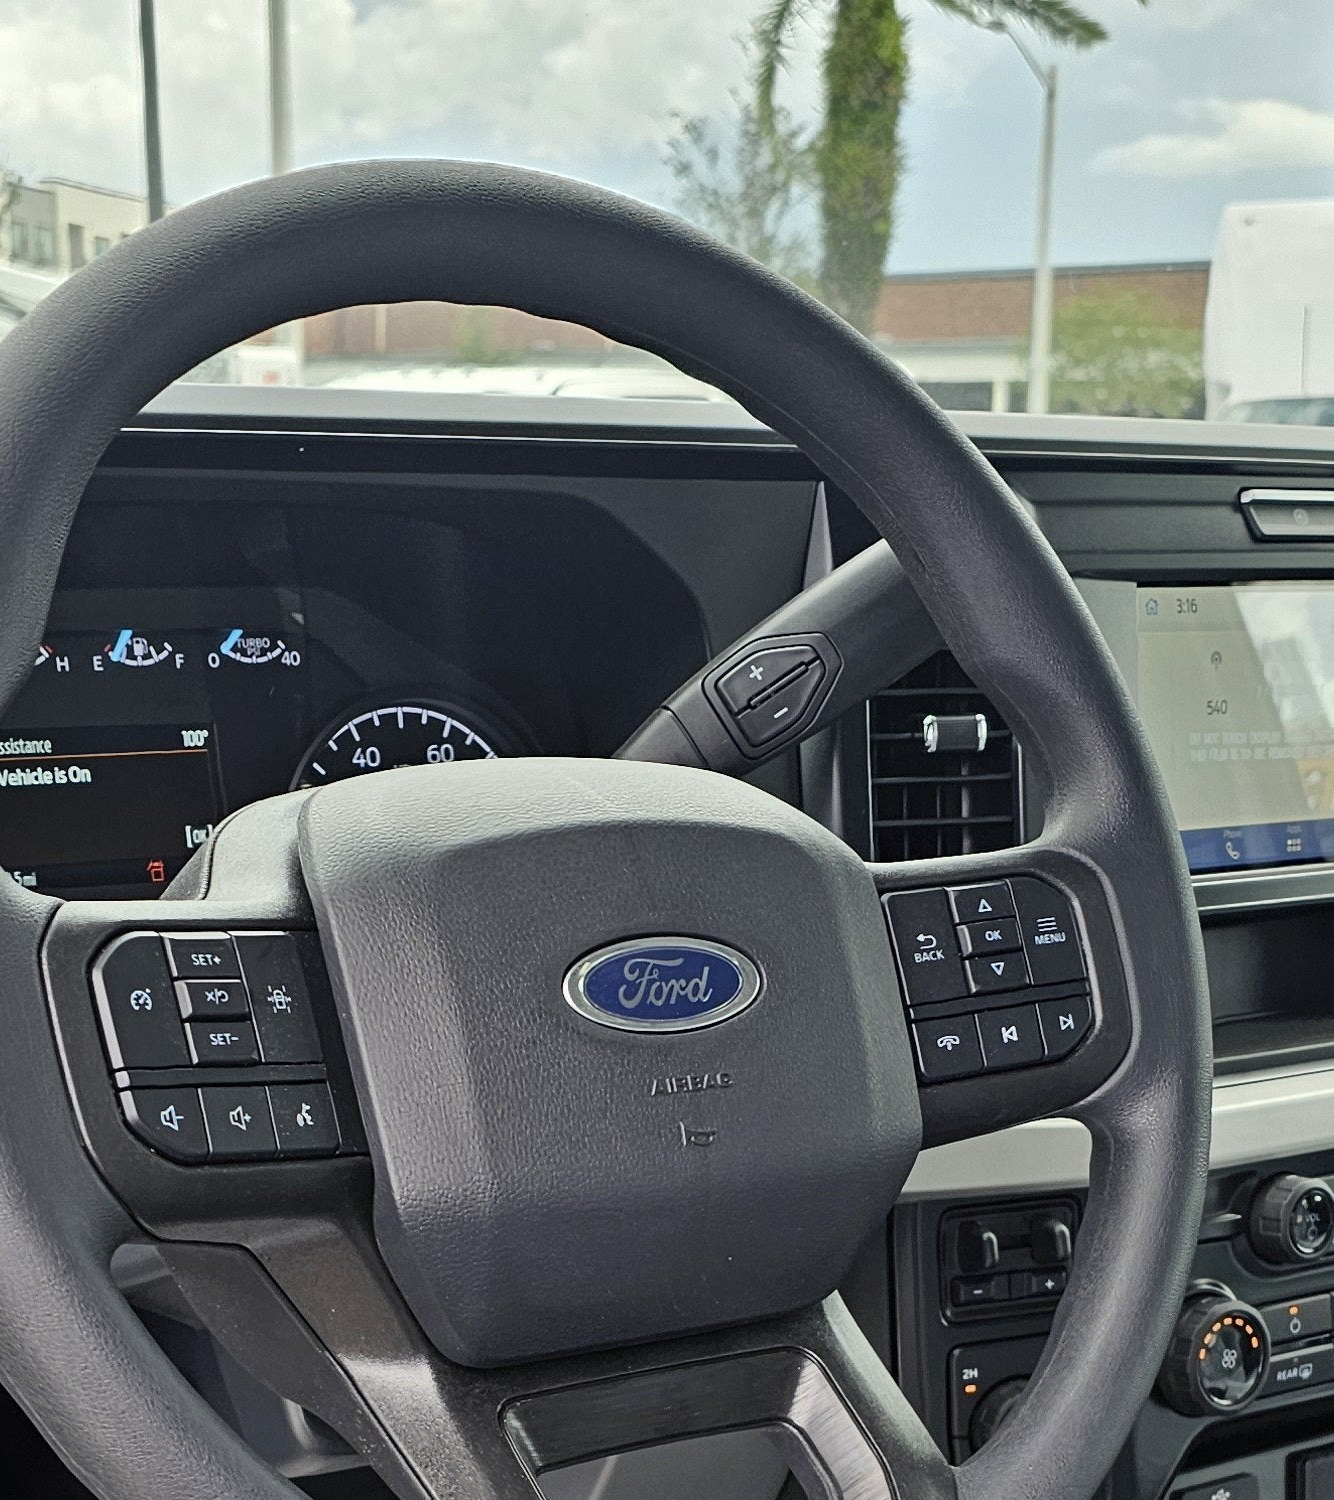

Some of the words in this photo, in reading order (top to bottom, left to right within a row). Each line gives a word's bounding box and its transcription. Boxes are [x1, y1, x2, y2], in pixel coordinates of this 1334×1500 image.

[1176, 598, 1198, 614] 3:16
[236, 637, 270, 649] TURBO
[56, 656, 70, 672] H
[93, 655, 104, 672] E
[176, 654, 184, 669] F
[281, 650, 301, 666] 40
[1207, 700, 1228, 716] 540
[352, 746, 381, 768] 40
[426, 743, 455, 763] 60
[54, 767, 67, 784] is
[68, 766, 92, 783] On
[984, 930, 1003, 942] OK
[1034, 932, 1066, 945] MENU
[914, 949, 945, 963] BACK
[618, 957, 713, 1009] Ford
[651, 1072, 733, 1096] AIRBAG
[962, 1368, 979, 1380] 2H
[1276, 1367, 1298, 1381] REAR
